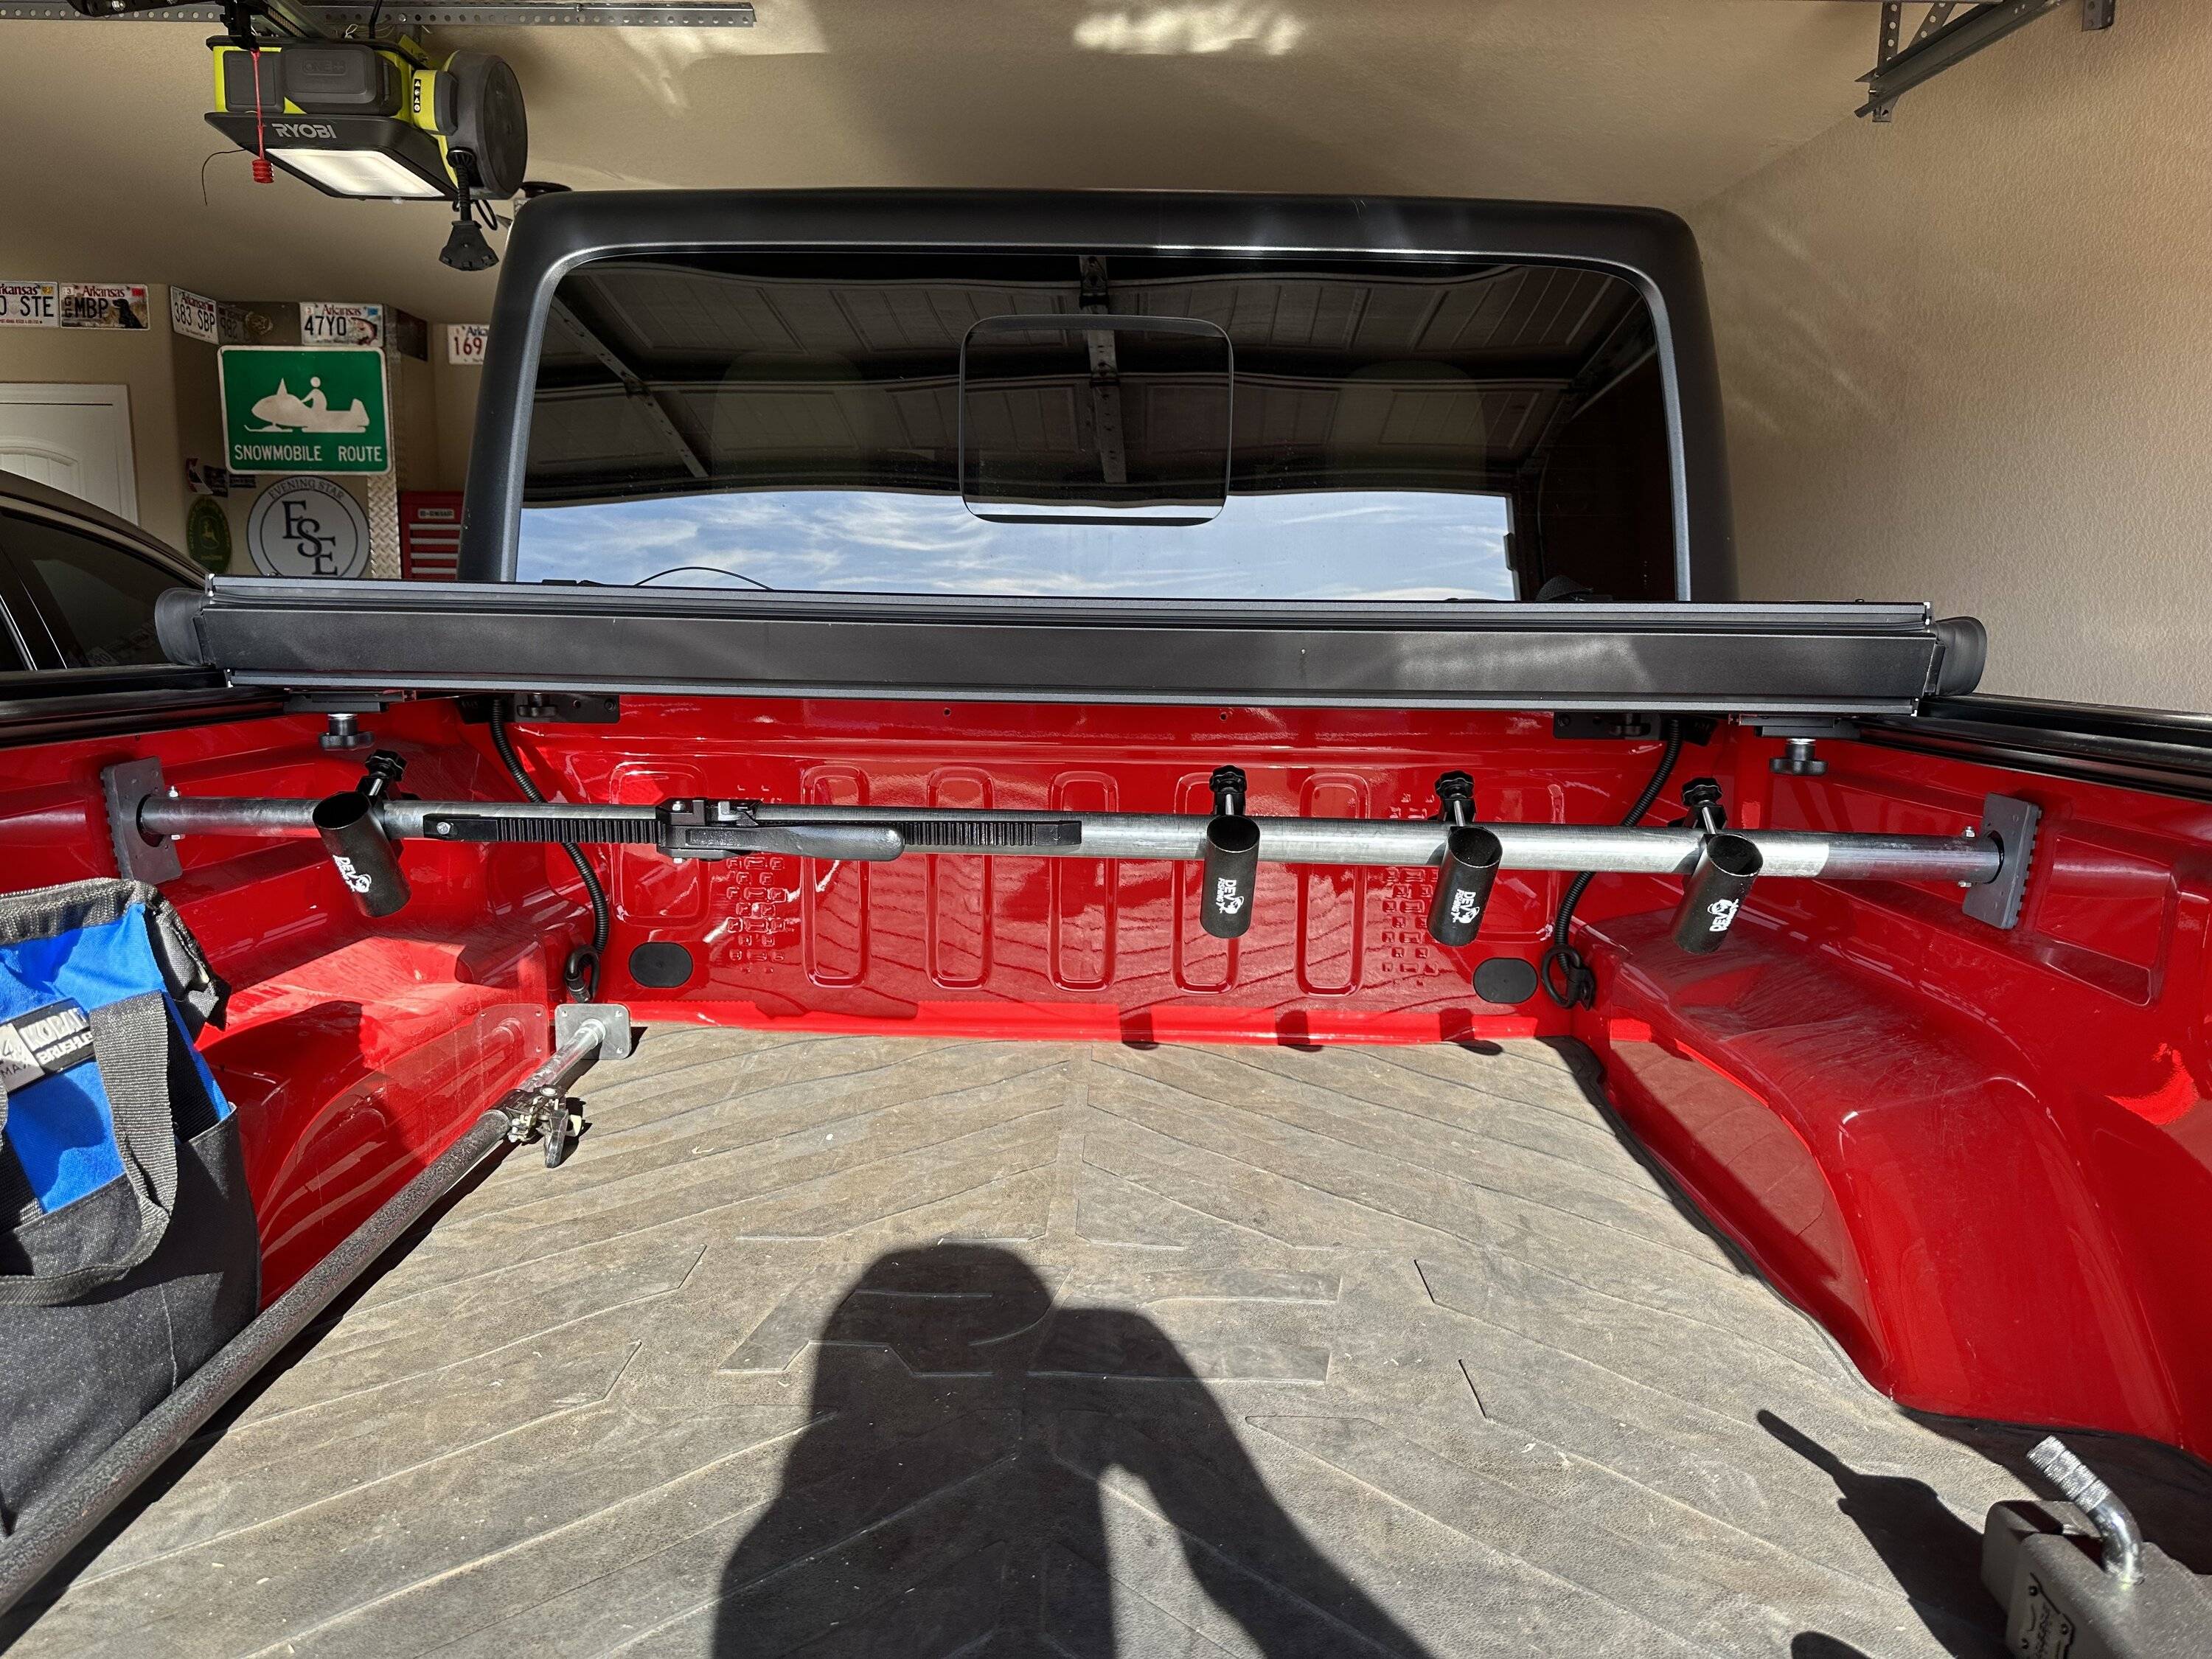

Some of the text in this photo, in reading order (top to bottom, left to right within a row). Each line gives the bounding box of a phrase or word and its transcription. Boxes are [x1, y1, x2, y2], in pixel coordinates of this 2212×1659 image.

[271, 123, 337, 139] RYOBI
[83, 285, 125, 298] Arkansas
[20, 295, 54, 317] STE
[74, 297, 108, 319] MBP
[322, 305, 361, 316] Arkansas
[174, 302, 192, 326] 383
[197, 309, 215, 333] SBP
[454, 337, 482, 355] 169
[234, 445, 383, 462] SNOWMOBILE ROUTE
[268, 478, 345, 501] EVENING STAR
[1224, 880, 1237, 901] DEV
[1460, 891, 1476, 911] DEV
[1709, 912, 1728, 932] DEV
